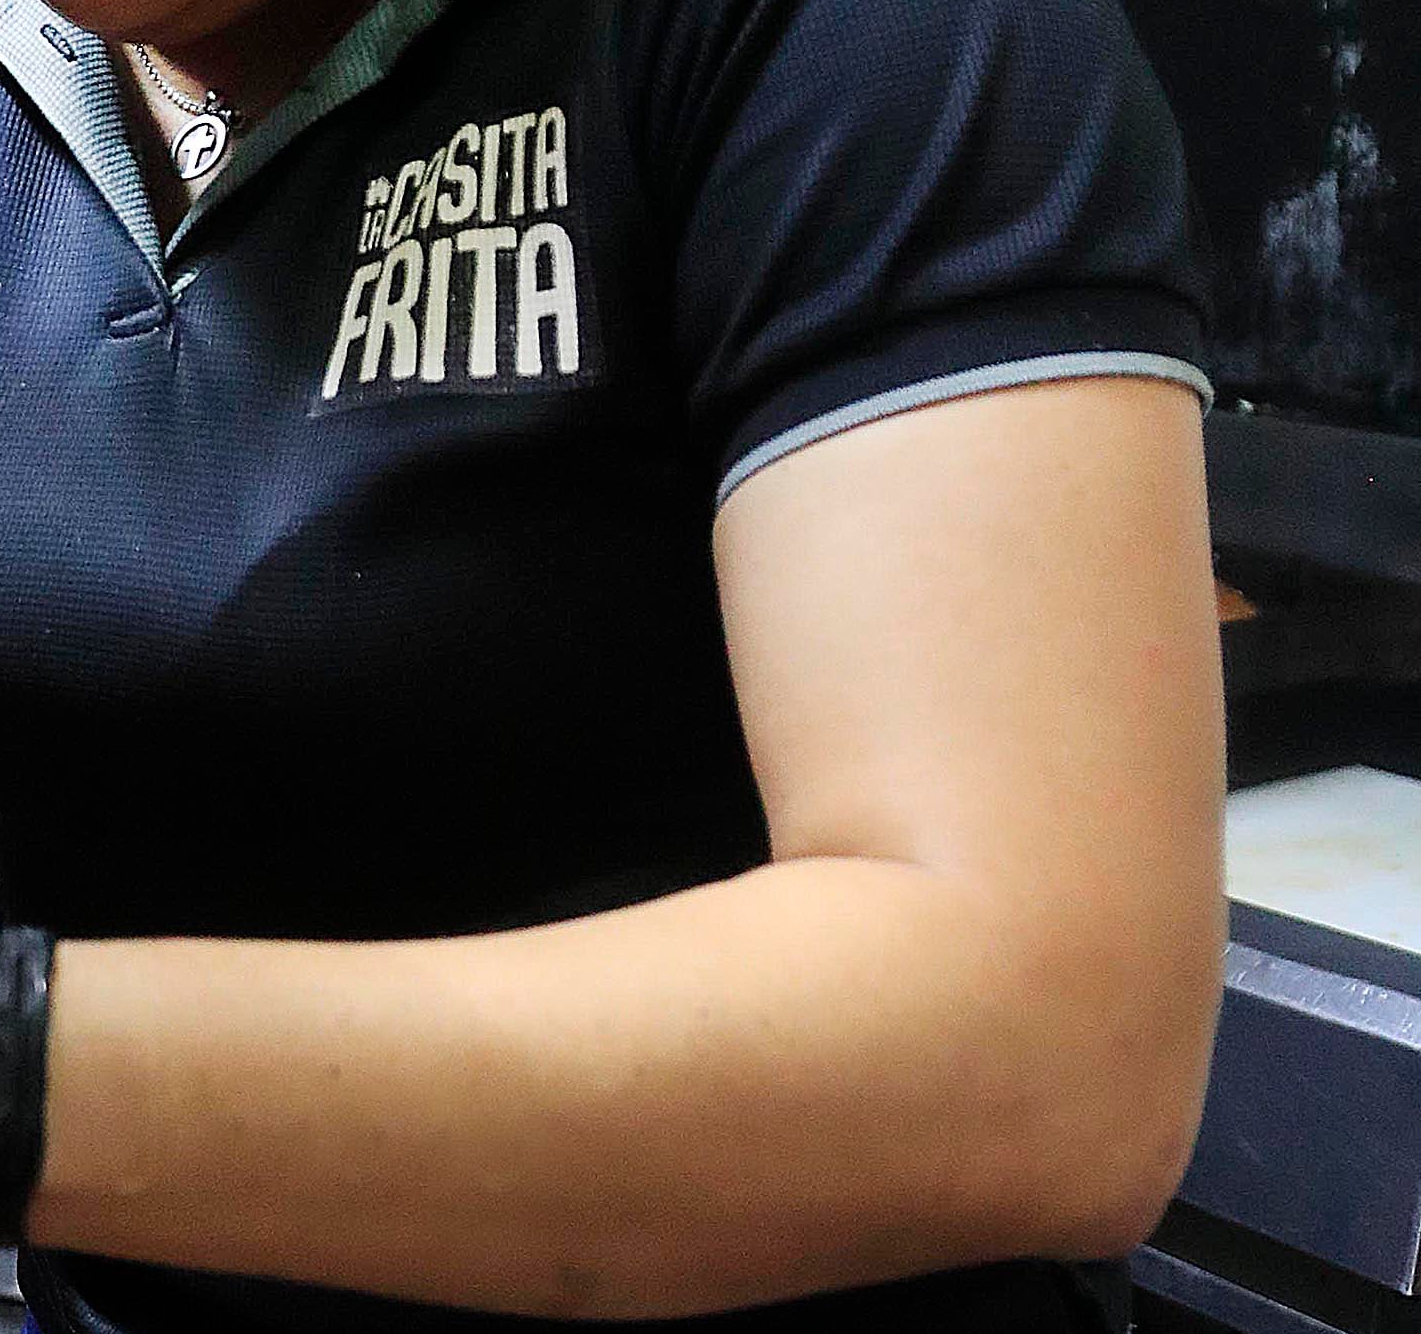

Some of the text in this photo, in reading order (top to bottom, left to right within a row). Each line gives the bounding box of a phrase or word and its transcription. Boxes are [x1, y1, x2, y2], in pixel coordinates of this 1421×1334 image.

[358, 106, 569, 254] LA CASITA
[322, 222, 580, 400] FRITA
